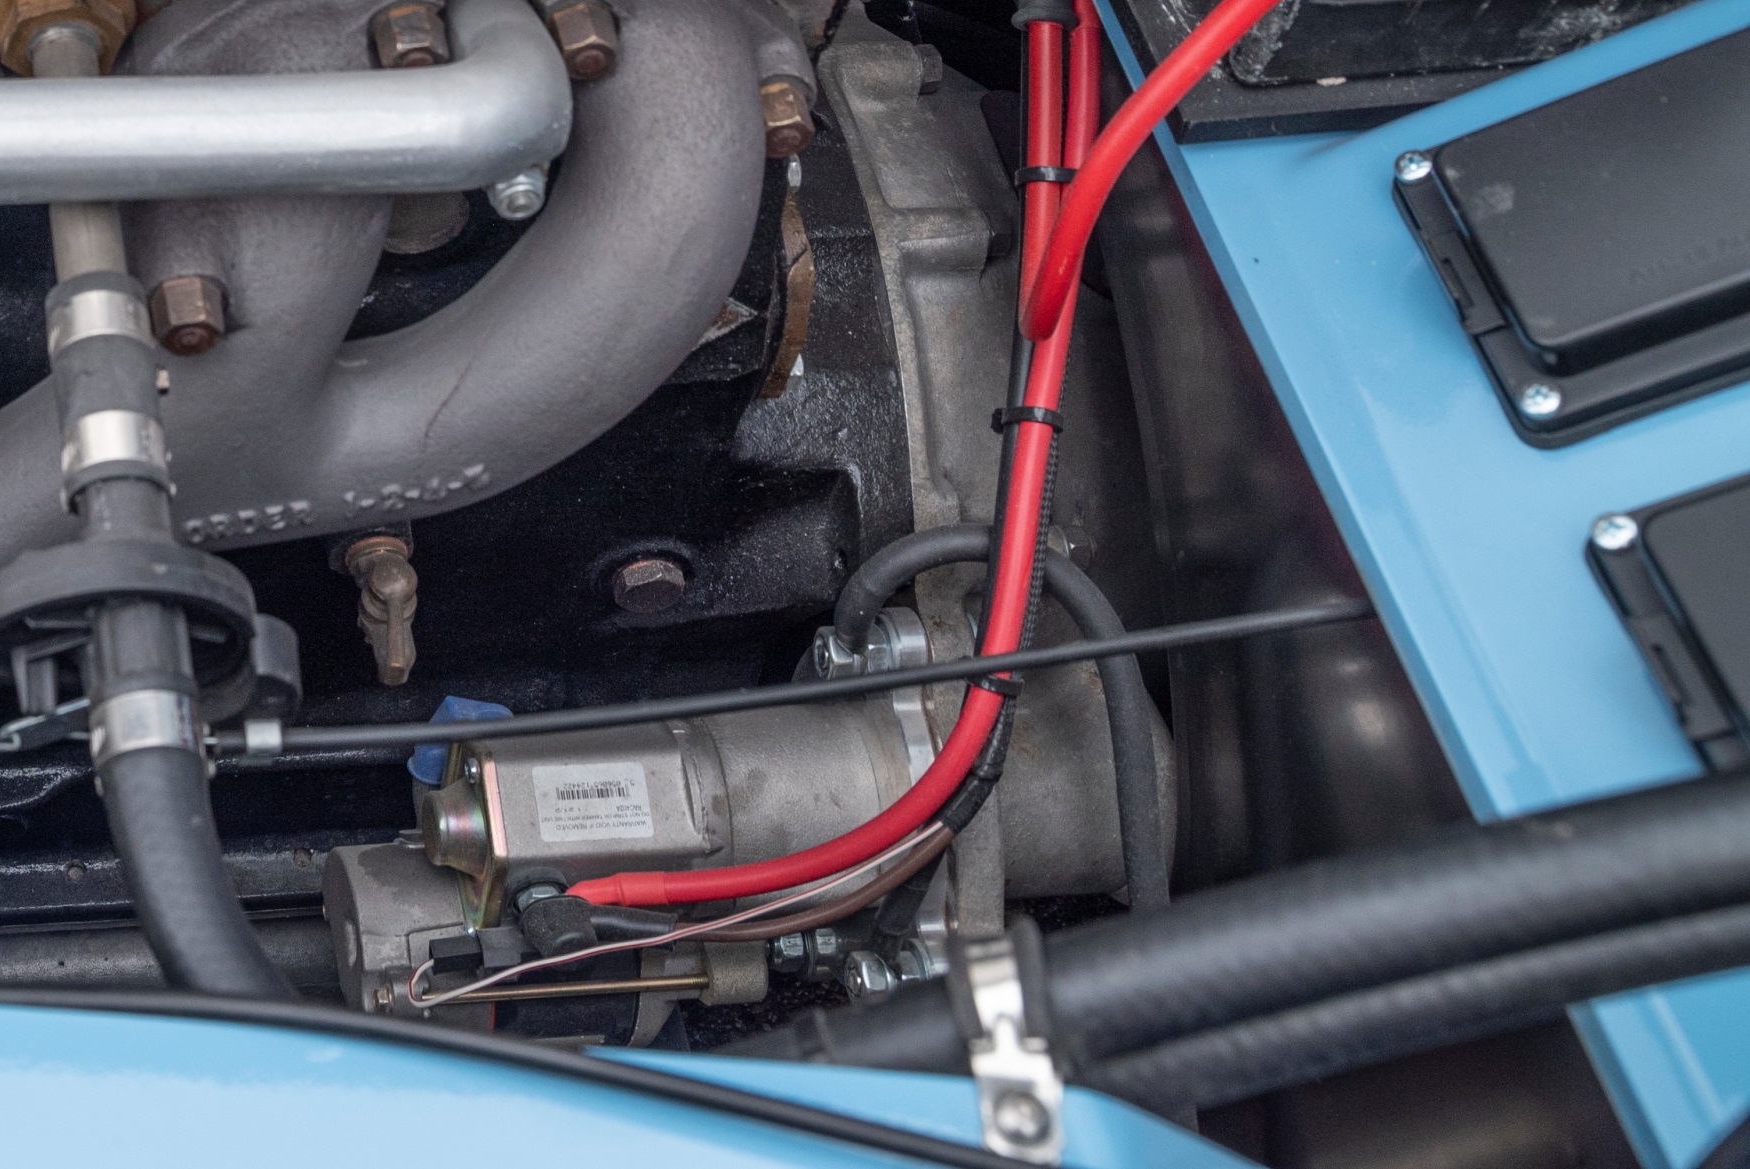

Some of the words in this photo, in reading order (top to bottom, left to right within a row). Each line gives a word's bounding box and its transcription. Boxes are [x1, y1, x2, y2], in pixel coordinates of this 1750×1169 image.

[556, 823, 588, 831] REMOVED
[595, 821, 612, 829] VOID
[612, 820, 647, 828] WARRANTY
